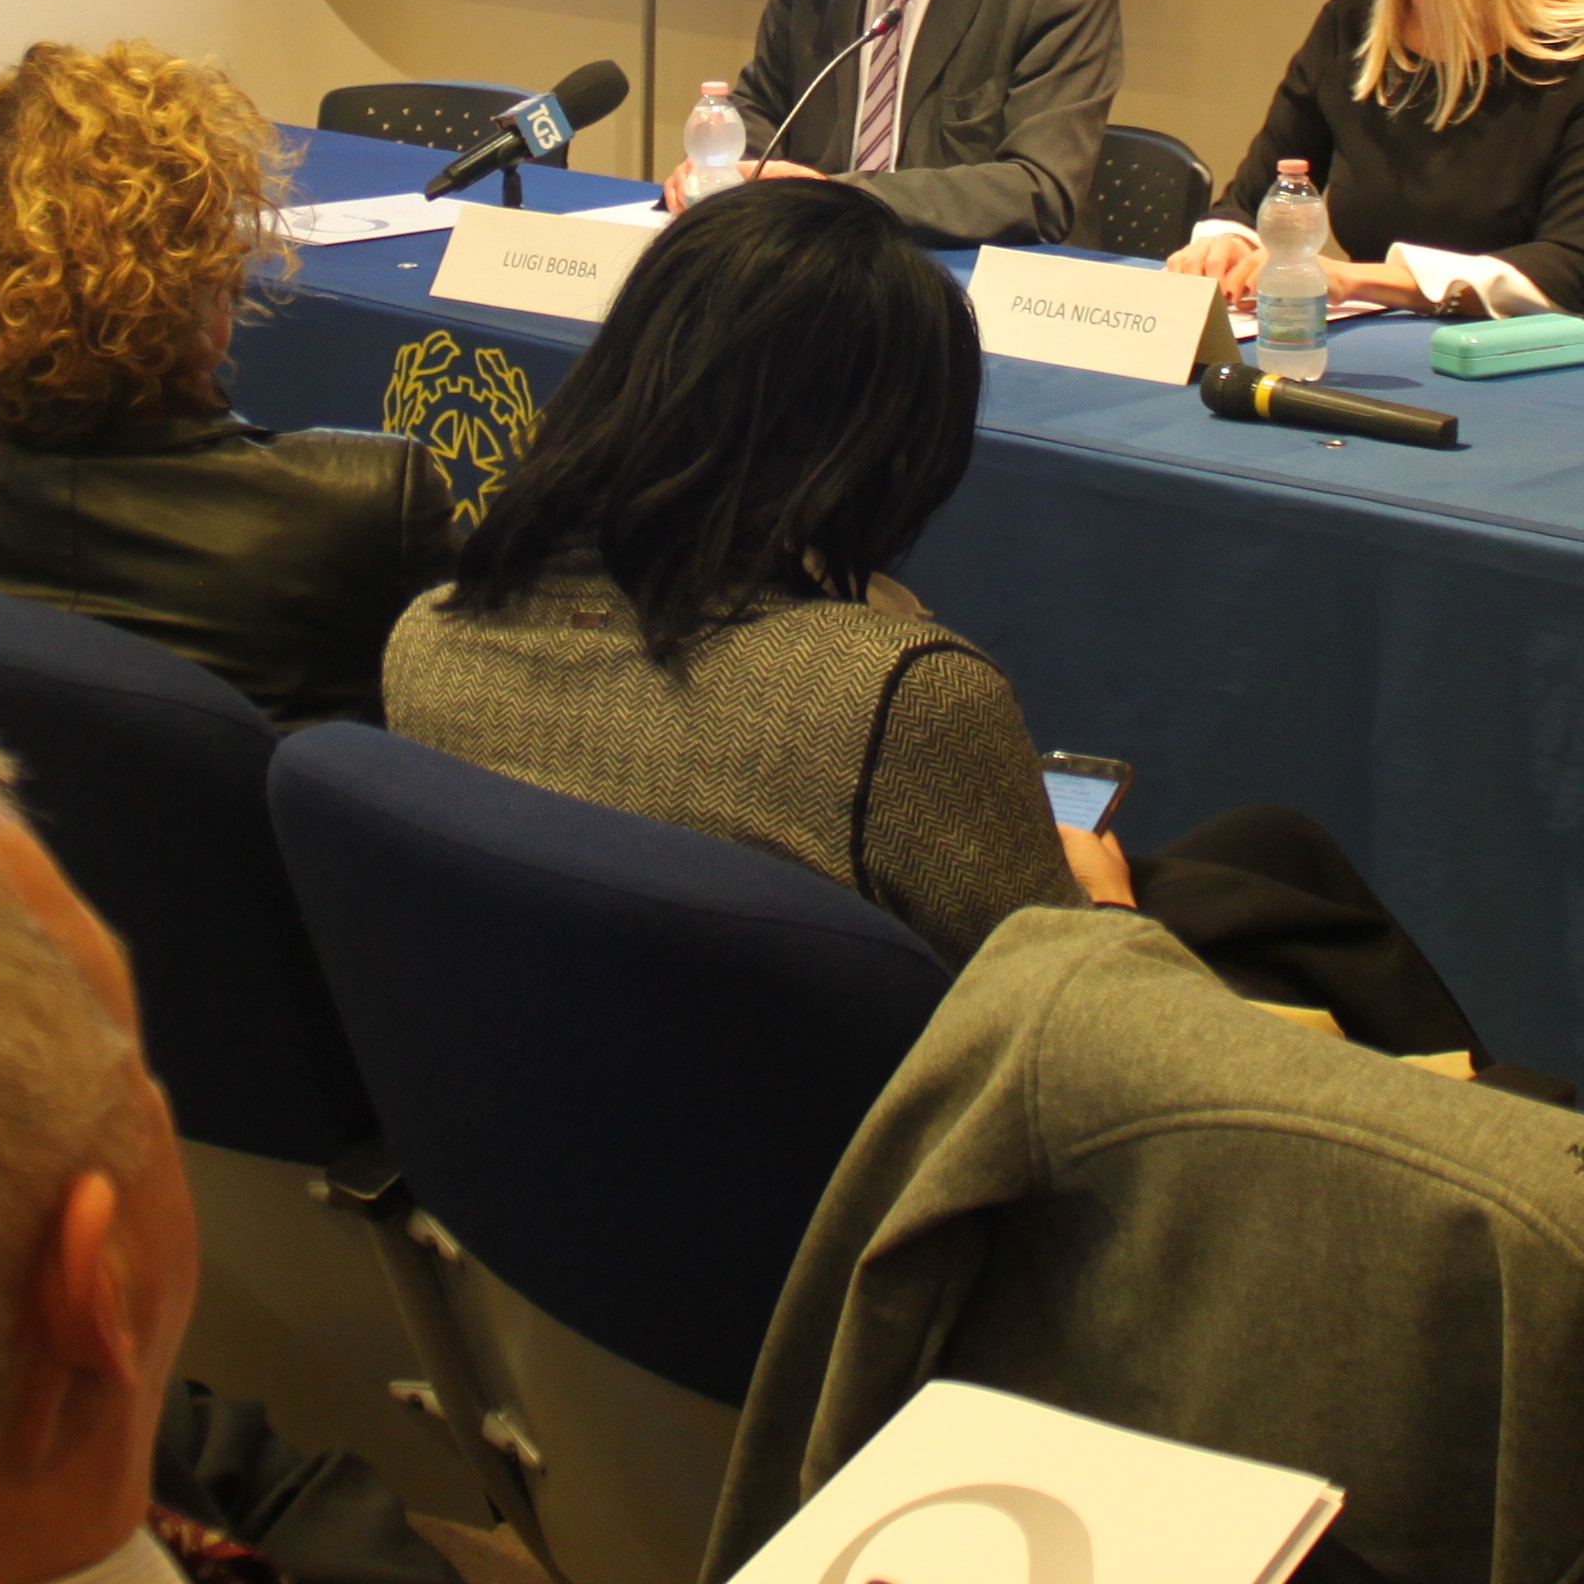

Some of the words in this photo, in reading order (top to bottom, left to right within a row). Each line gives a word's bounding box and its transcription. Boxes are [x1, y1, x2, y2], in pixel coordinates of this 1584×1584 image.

[526, 103, 563, 150] TG3
[502, 251, 544, 272] LUIGI
[545, 256, 597, 280] BOBBA
[1010, 295, 1066, 320] PAOLA
[1070, 304, 1158, 334] NICASTRO
